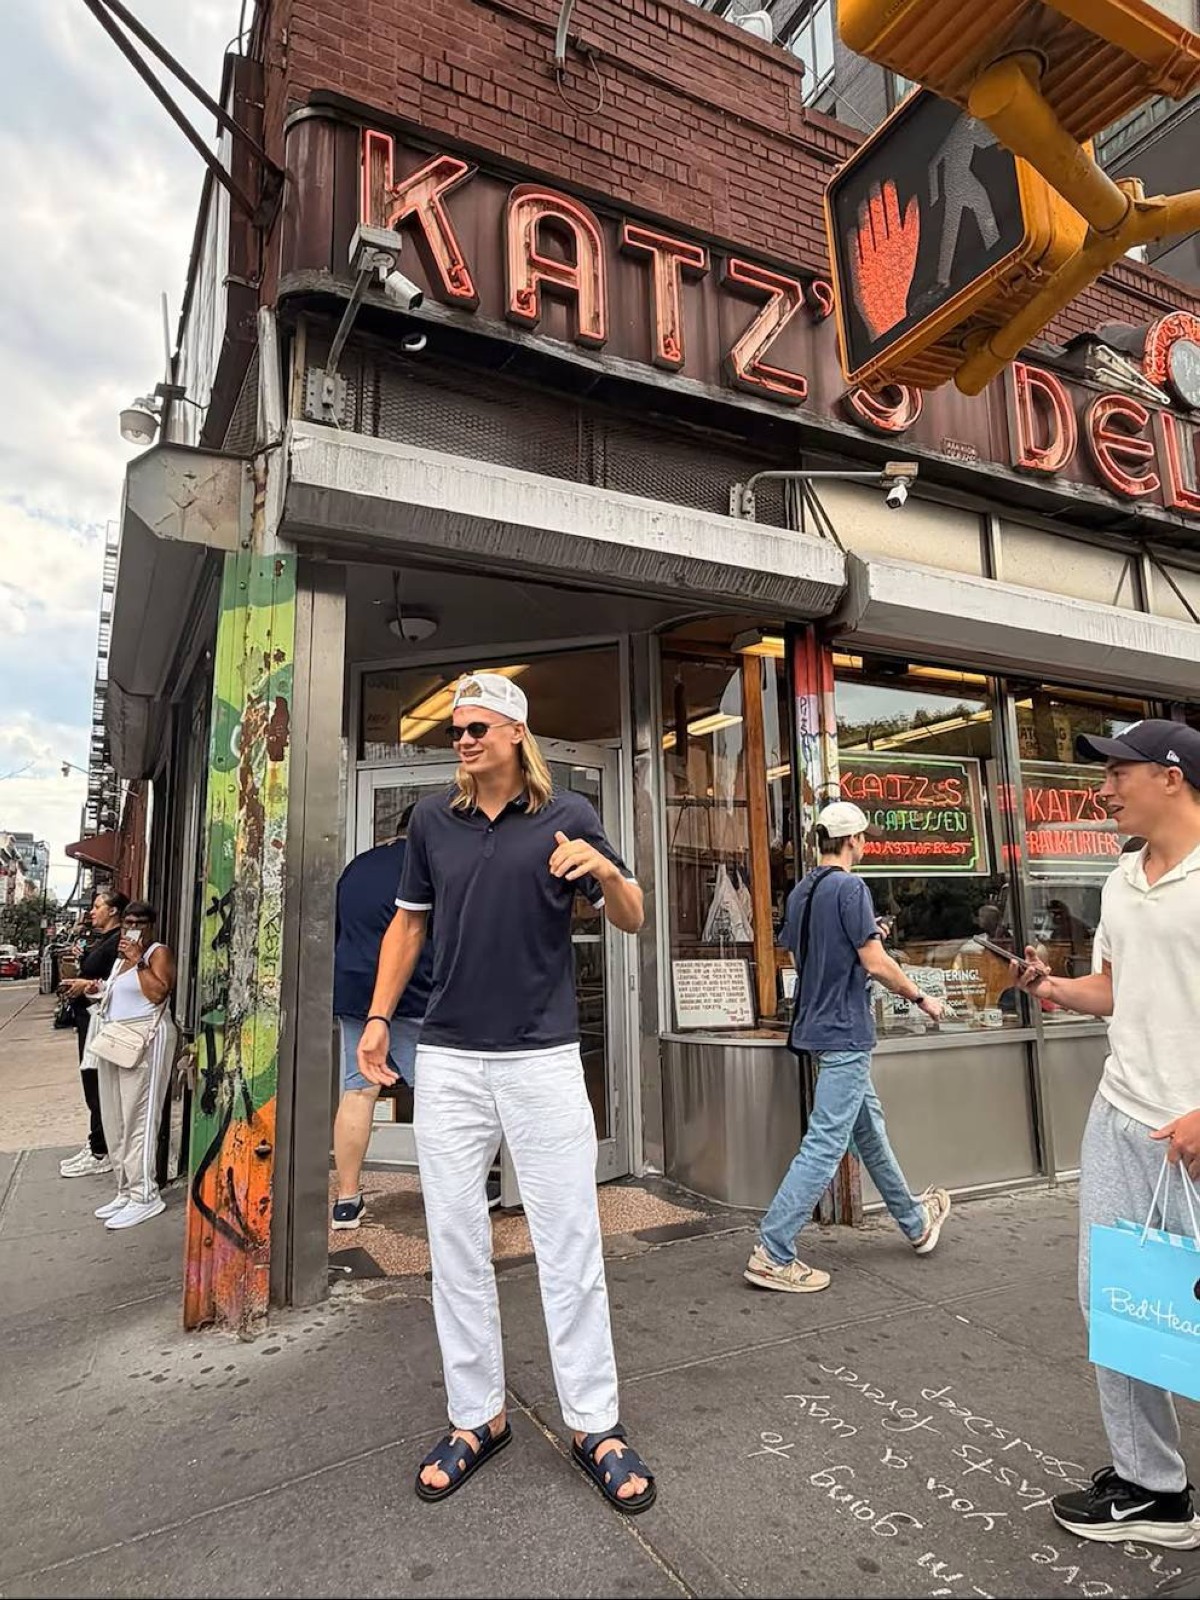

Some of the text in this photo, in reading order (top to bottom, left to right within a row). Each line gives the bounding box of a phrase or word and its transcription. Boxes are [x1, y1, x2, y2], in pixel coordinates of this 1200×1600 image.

[865, 809, 968, 832] ICATESSEN
[1027, 787, 1108, 823] KATZ'S
[784, 1395, 858, 1437] way
[819, 1364, 942, 1434] forever
[747, 1432, 795, 1459] to
[809, 1465, 923, 1536] going
[951, 1443, 1056, 1510] lasts
[927, 1477, 1008, 1531] you
[1030, 1545, 1115, 1598] ove
